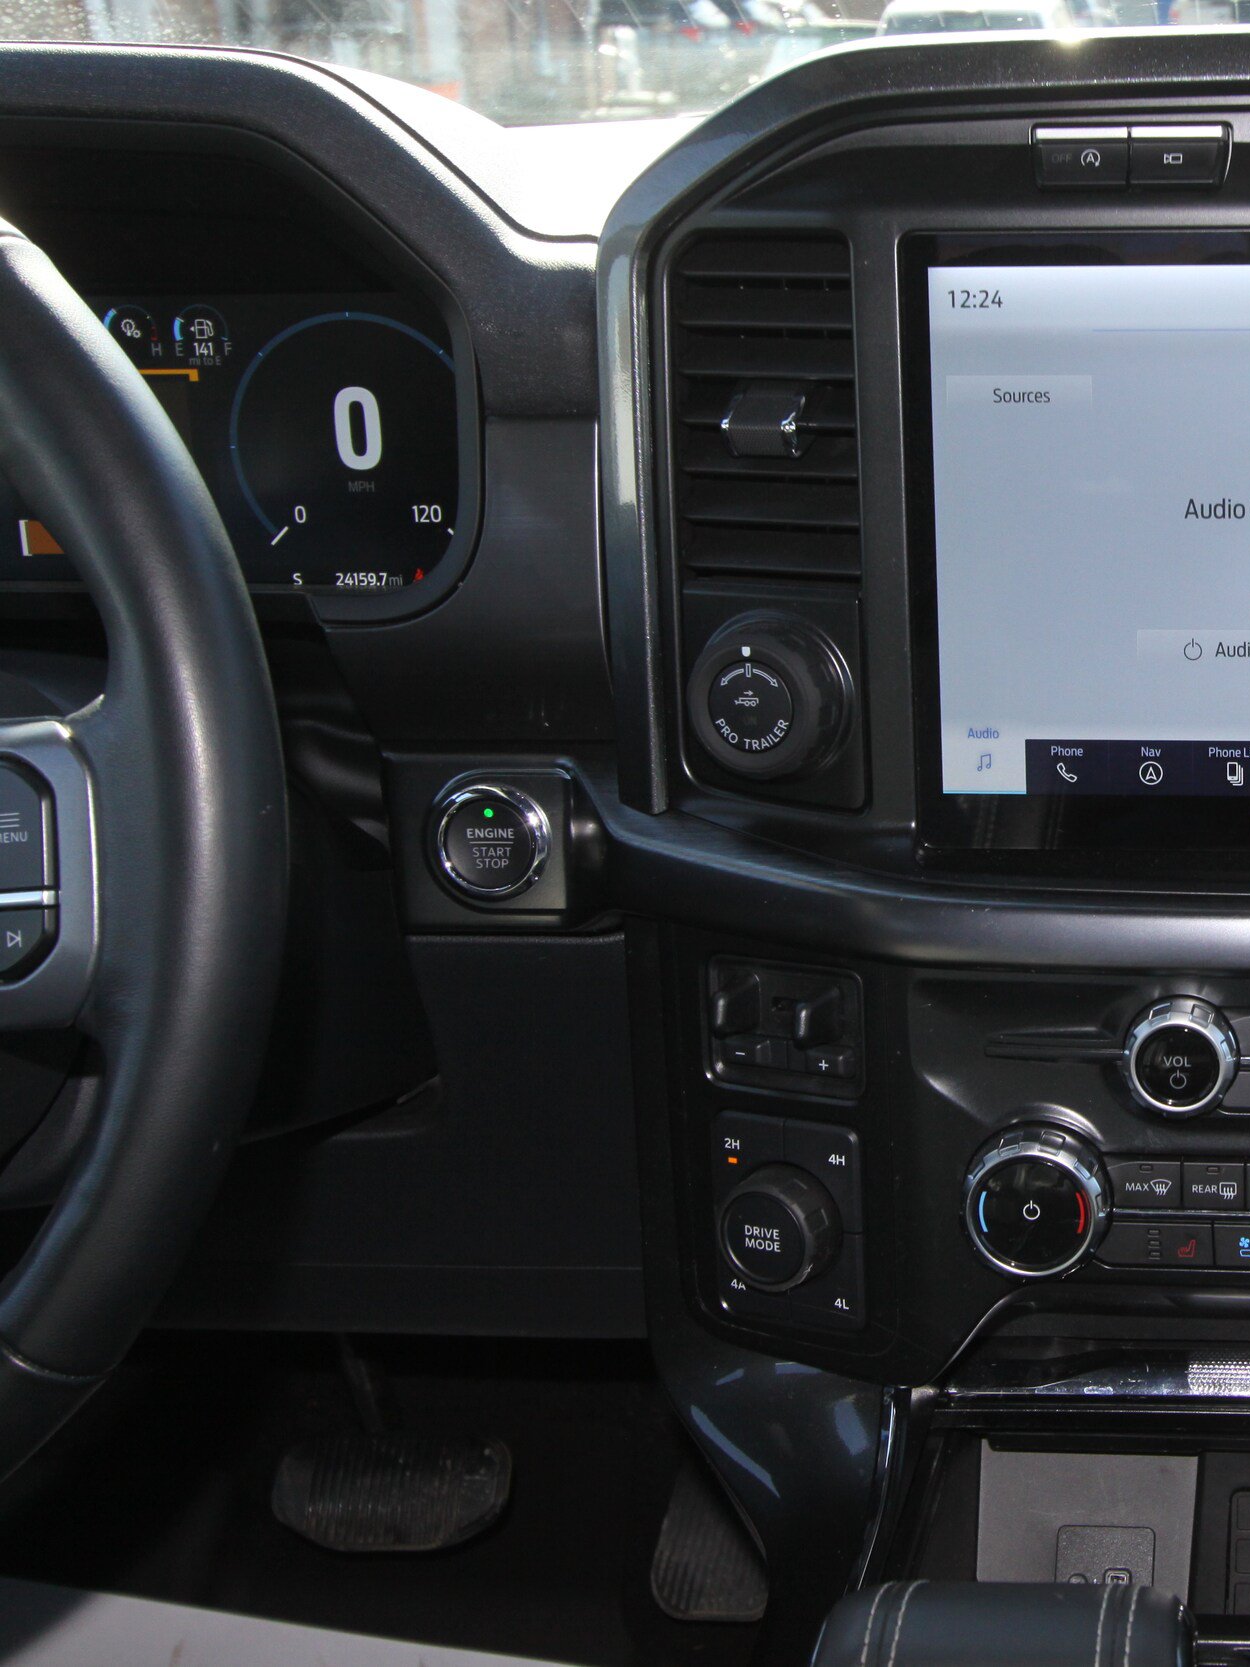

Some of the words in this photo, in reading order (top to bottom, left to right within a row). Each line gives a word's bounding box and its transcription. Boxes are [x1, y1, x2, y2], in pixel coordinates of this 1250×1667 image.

[947, 289, 1003, 309] 12:24
[151, 342, 162, 357] H
[175, 342, 184, 357] E
[193, 342, 214, 356] 141
[224, 342, 232, 356] F
[992, 387, 1051, 404] Sources
[334, 386, 382, 470] 0
[348, 480, 375, 493] MPH
[294, 505, 307, 524] 0
[411, 505, 442, 524] 120
[1184, 498, 1246, 519] Audio
[293, 572, 302, 586] S
[335, 572, 387, 587] 24159.7
[715, 718, 739, 744] PRO
[743, 719, 789, 750] TRAILER
[967, 728, 999, 739] Audio
[1050, 745, 1083, 757] Phone
[1140, 746, 1161, 757] Nav
[1208, 746, 1240, 758] Phone
[467, 828, 515, 839] ENGINE
[472, 847, 512, 858] START
[476, 858, 509, 869] STOP
[1163, 1055, 1192, 1068] VOL
[724, 1138, 740, 1150] 2H
[828, 1154, 845, 1166] 4H
[1125, 1182, 1149, 1192] MAX
[1192, 1184, 1218, 1194] REAR
[744, 1224, 780, 1240] DRIVE
[745, 1238, 781, 1252] MODE
[834, 1298, 849, 1309] 4L
